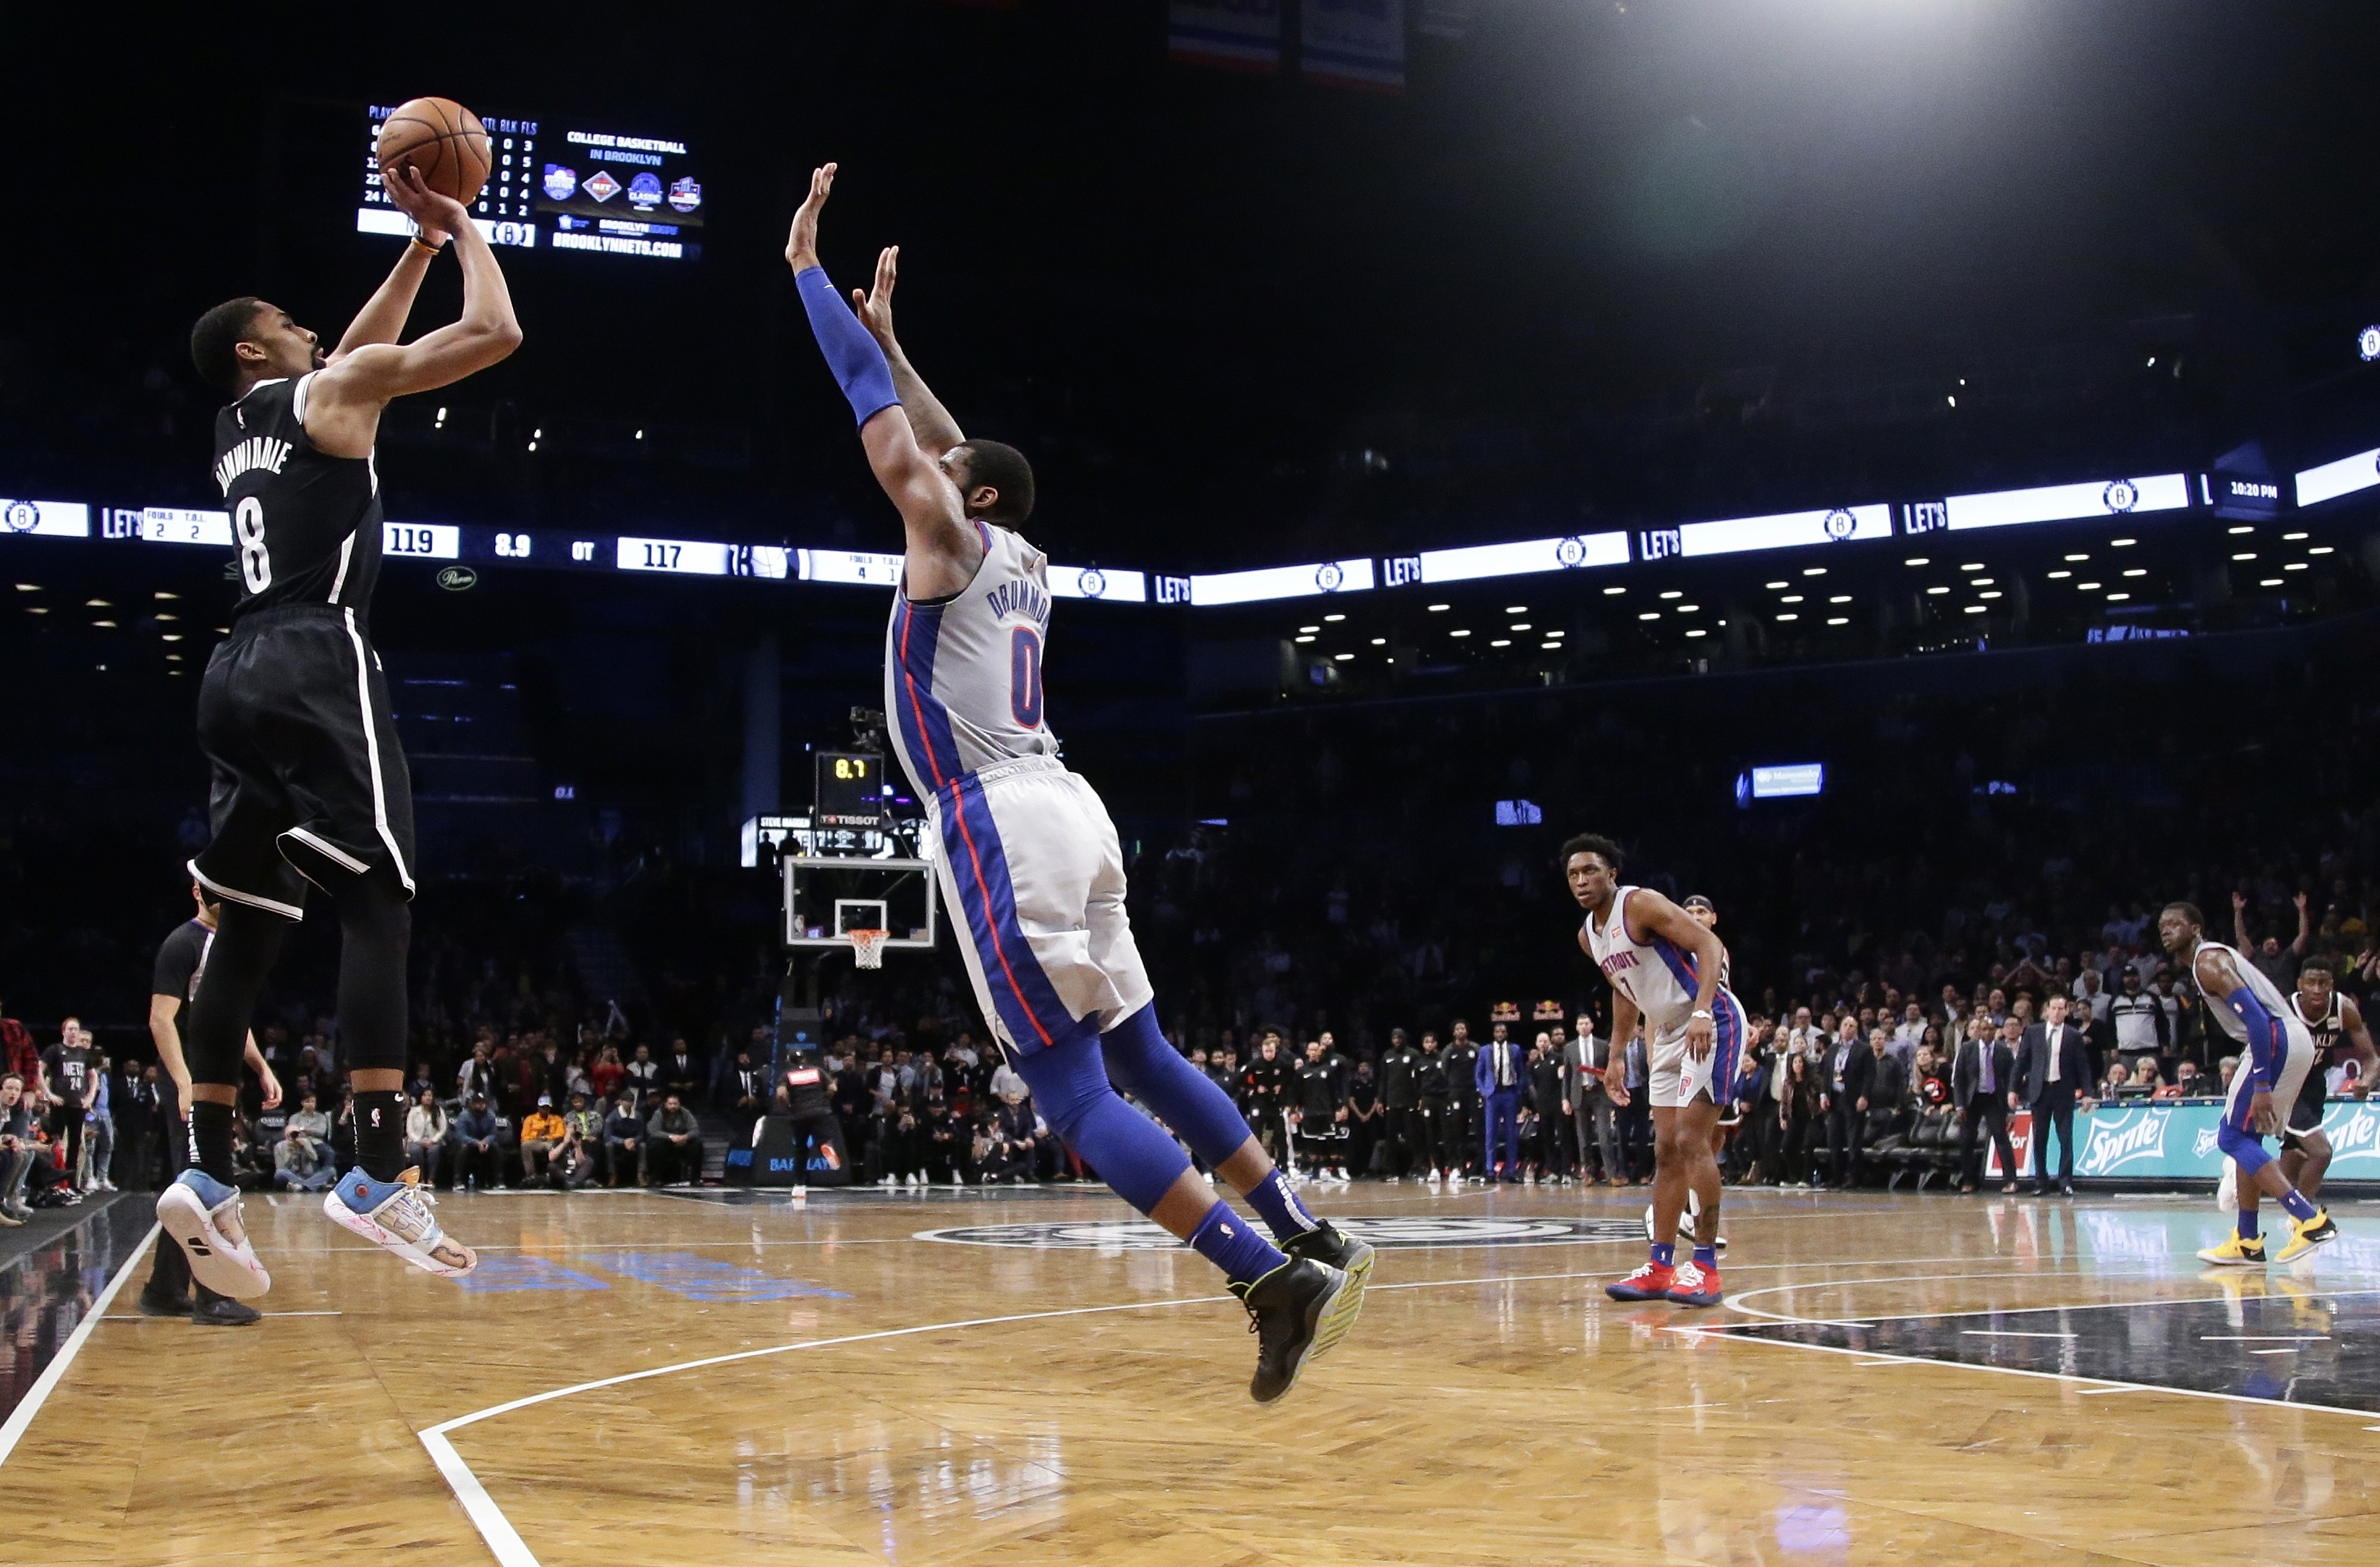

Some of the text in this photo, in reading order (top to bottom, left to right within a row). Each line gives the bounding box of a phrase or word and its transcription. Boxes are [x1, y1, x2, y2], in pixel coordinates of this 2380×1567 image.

[369, 105, 538, 135] PLAYE STL BLK FLS
[503, 138, 513, 150] 0
[524, 140, 533, 152] 3
[567, 131, 687, 154] COLLEGE BASKETBALL
[502, 154, 512, 166] 0
[522, 156, 531, 168] 5
[590, 149, 662, 166] IN BROOKLYN
[501, 170, 510, 182] 0
[520, 173, 530, 184] 4
[364, 190, 381, 202] 24
[478, 201, 488, 212] 0
[498, 203, 507, 214] 1
[518, 205, 528, 216] 2
[480, 185, 488, 196] 2
[499, 187, 509, 198] 0
[520, 189, 529, 200] 4
[553, 232, 682, 258] BROOKLYNNETS.COM
[2231, 481, 2259, 497] 10:20
[2261, 484, 2278, 499] PM
[102, 507, 143, 538] LET'S
[146, 511, 174, 521] FOULS
[1904, 501, 1945, 535] LET'S
[156, 523, 199, 539] 2 2
[235, 496, 272, 595] 8
[390, 527, 682, 569] 119 8.9 OT 117
[1640, 530, 1680, 561] LET'S
[850, 555, 872, 564] FOULS
[858, 566, 895, 581] 4 1
[1384, 557, 1420, 587] LET'S
[1156, 575, 1190, 603] LET'S
[986, 579, 1049, 629] DRUMMO
[1010, 626, 1043, 729] 0
[835, 759, 865, 779] 8.7
[761, 817, 782, 827] STEVE
[837, 815, 879, 825] TISSOT
[1600, 951, 1640, 977] ETROIT
[63, 1062, 85, 1076] NETS
[2326, 1106, 2375, 1152] rite
[2085, 1111, 2159, 1173] Sprite
